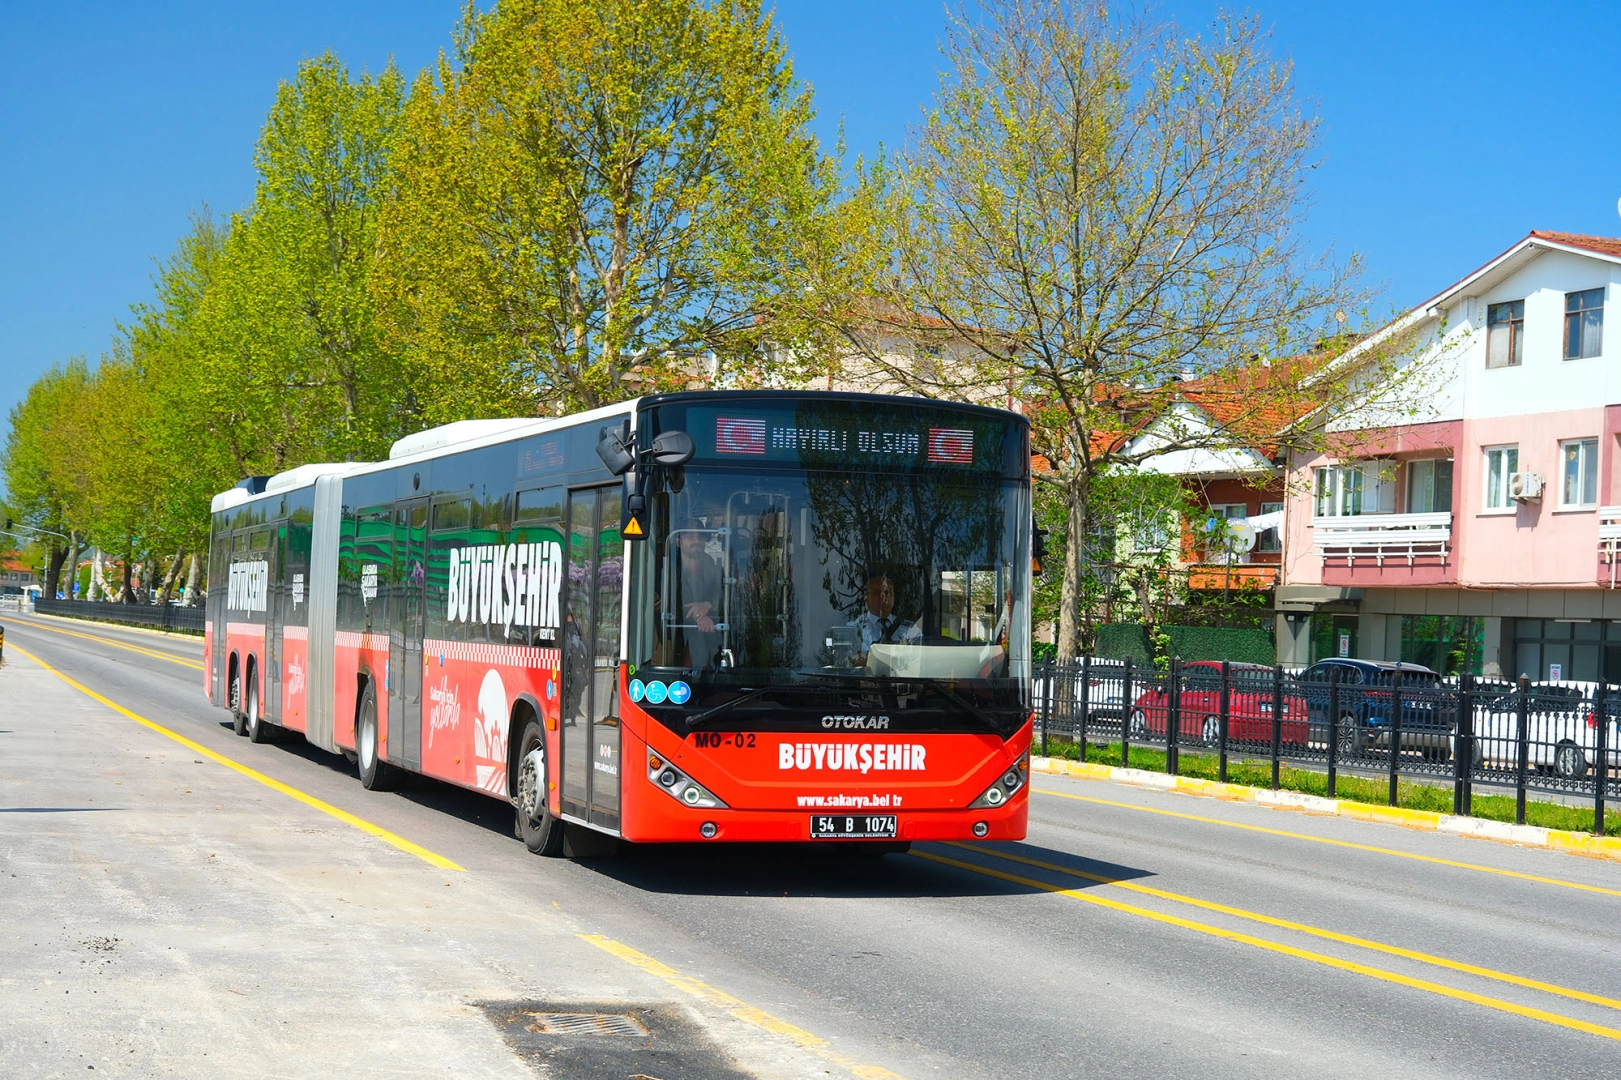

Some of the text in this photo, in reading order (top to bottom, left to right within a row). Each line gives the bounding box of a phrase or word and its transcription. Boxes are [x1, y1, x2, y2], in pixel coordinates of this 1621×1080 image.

[772, 427, 919, 454] HAYIRLI OLSUN
[447, 541, 563, 639] BÜYÜKŞEHİR
[821, 715, 890, 729] OTOKAR
[778, 743, 926, 774] BÜYÜKŞEHİR
[819, 817, 894, 832] 54 B 1074
